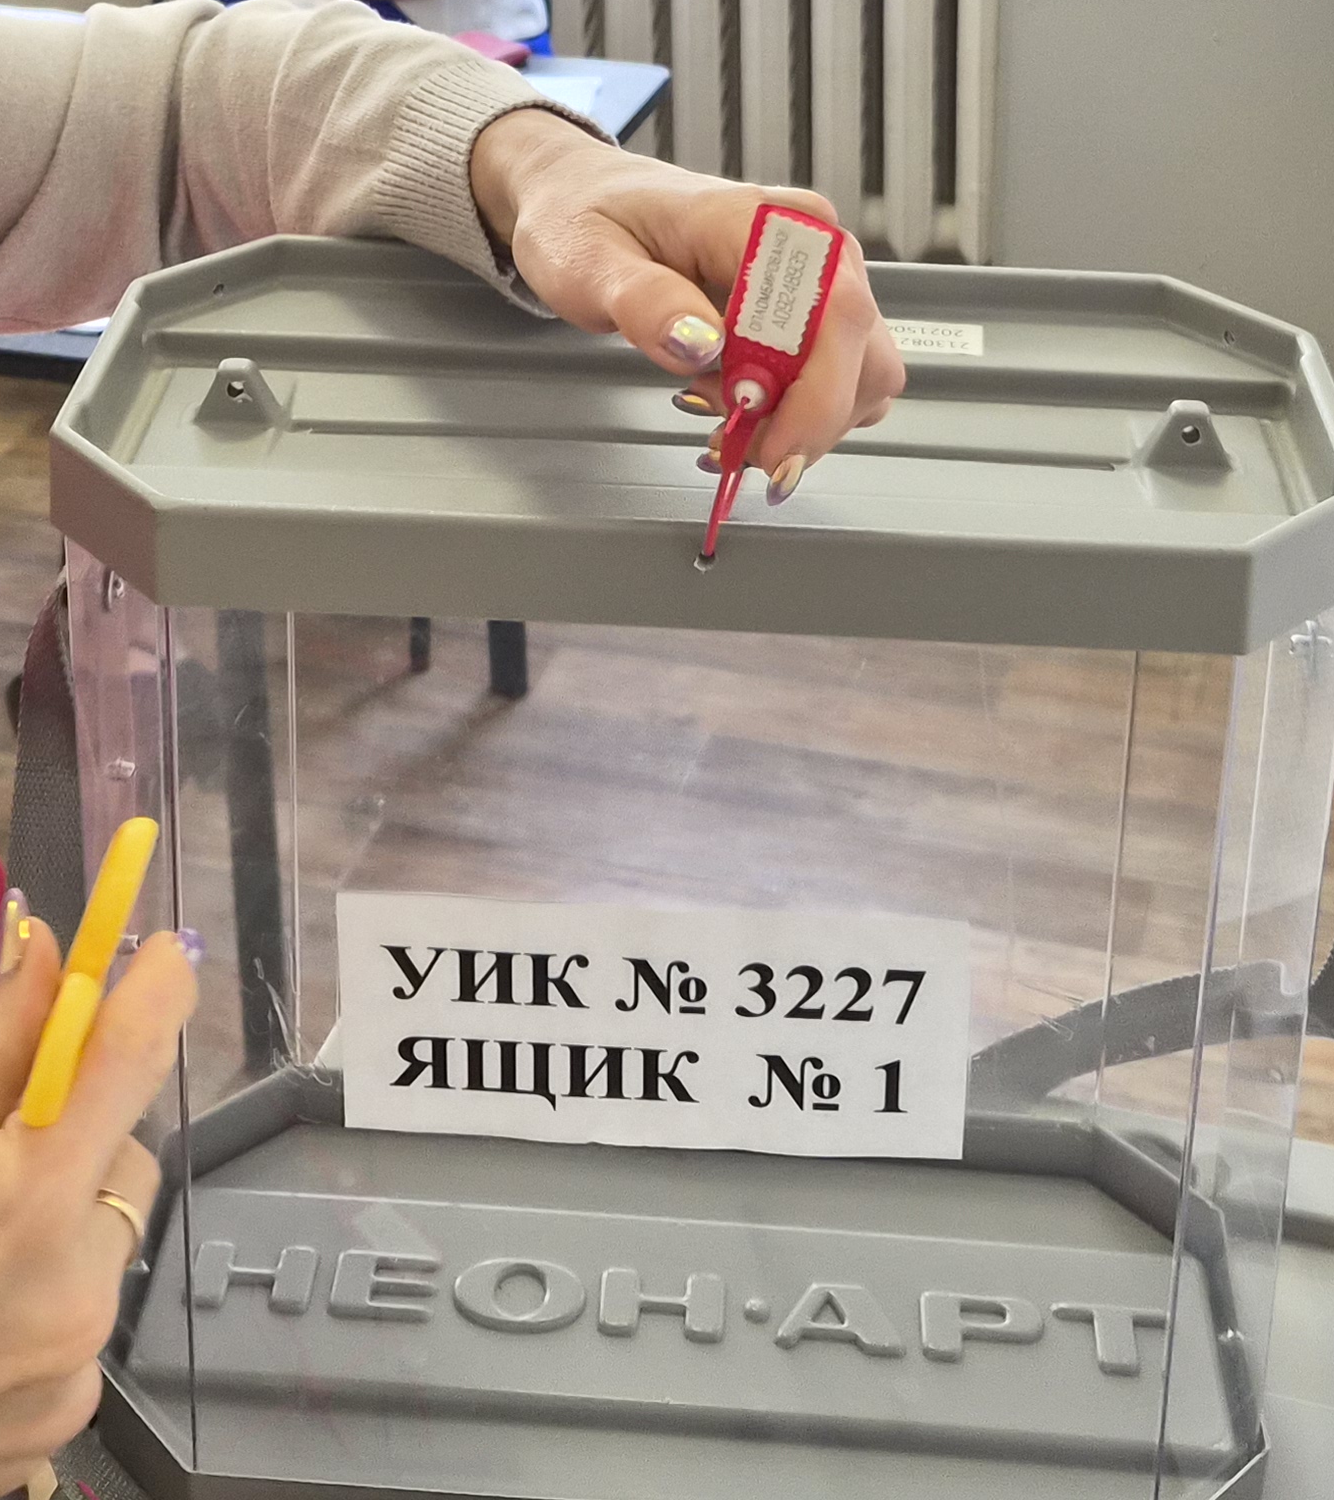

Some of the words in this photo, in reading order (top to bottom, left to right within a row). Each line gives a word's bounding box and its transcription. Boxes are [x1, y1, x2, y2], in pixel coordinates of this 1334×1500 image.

[380, 944, 590, 1009] УИК
[615, 956, 708, 1015] №
[734, 962, 927, 1025] 3227
[389, 1035, 700, 1111] ЯЩИК
[748, 1053, 842, 1112] №
[874, 1060, 908, 1113] 1
